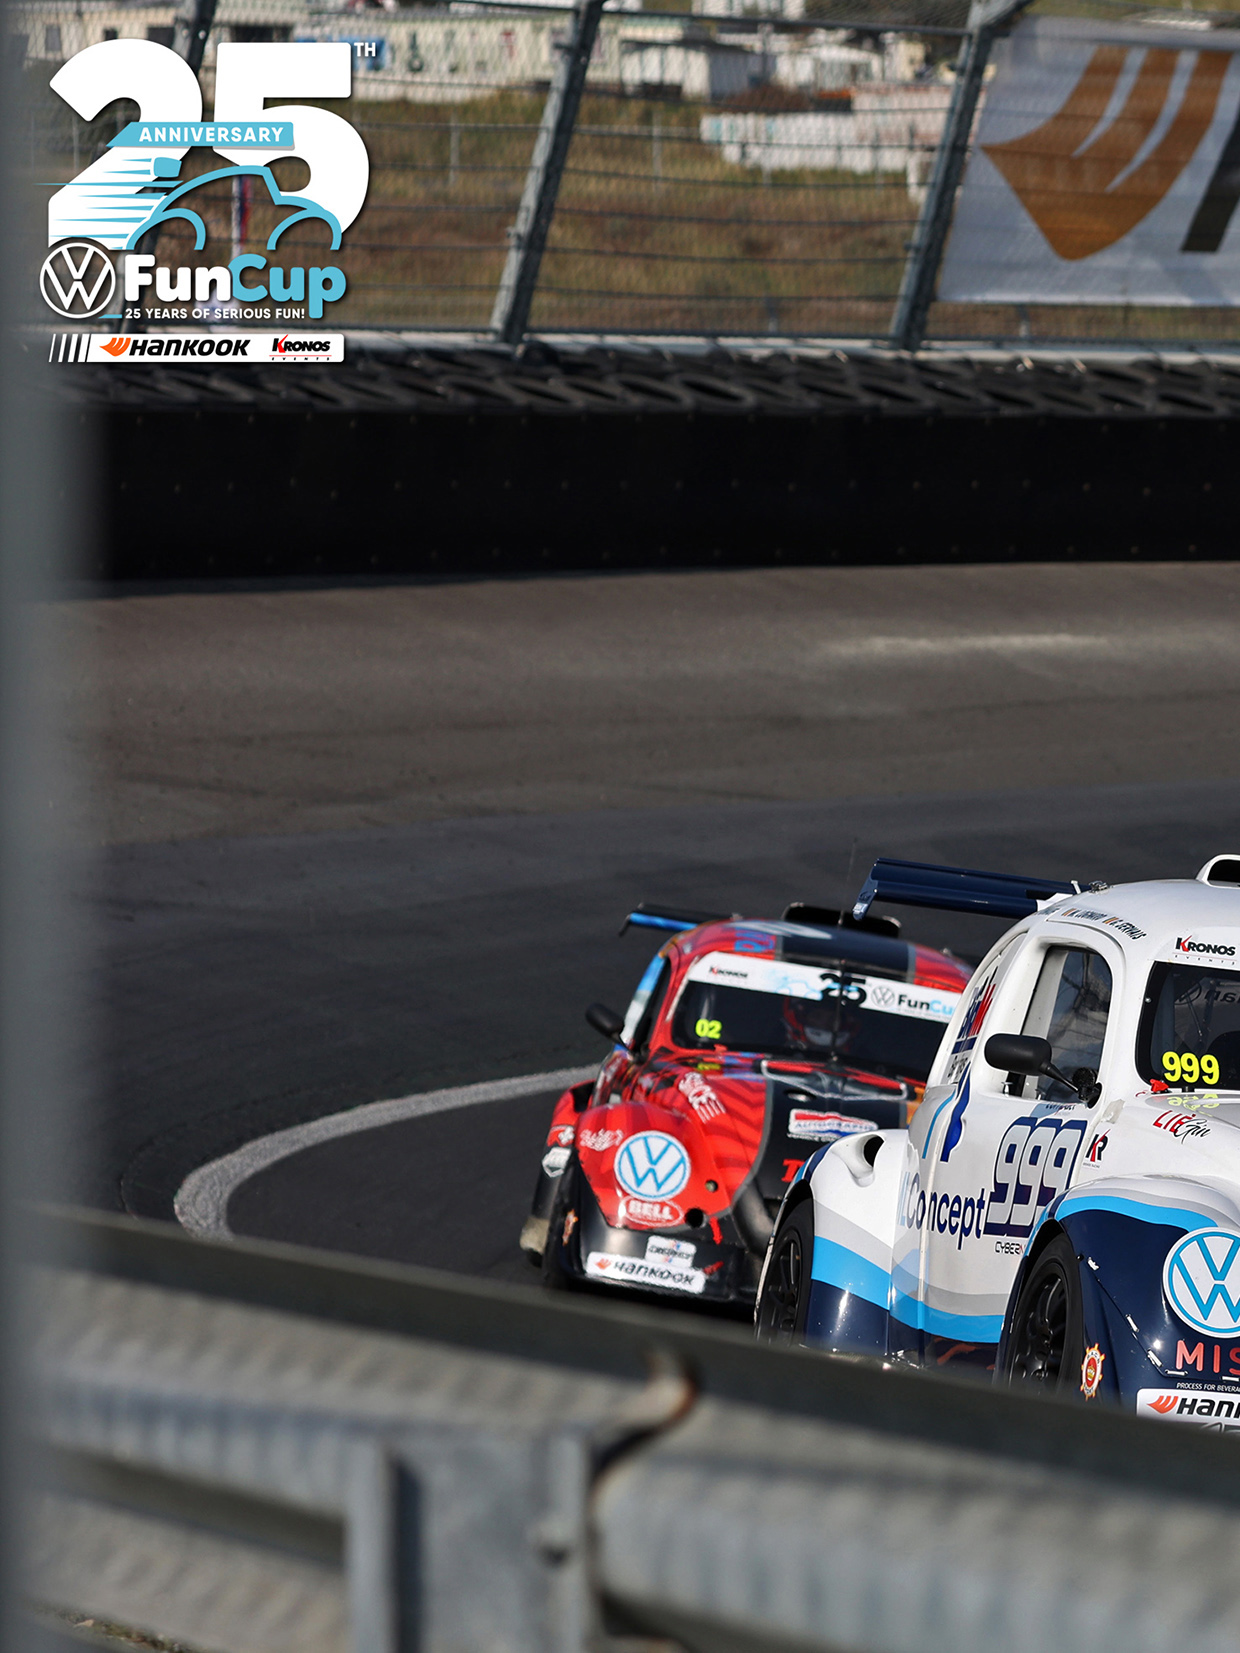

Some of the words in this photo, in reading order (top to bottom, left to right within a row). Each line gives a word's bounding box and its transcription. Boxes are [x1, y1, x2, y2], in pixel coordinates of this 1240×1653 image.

[1175, 935, 1236, 956] KRONOS
[898, 994, 958, 1016] FunCu
[695, 1018, 722, 1040] 02
[1162, 1051, 1220, 1085] 999
[984, 1117, 1077, 1237] 999
[628, 1200, 674, 1220] BELL
[1176, 1382, 1202, 1390] PROCESS
